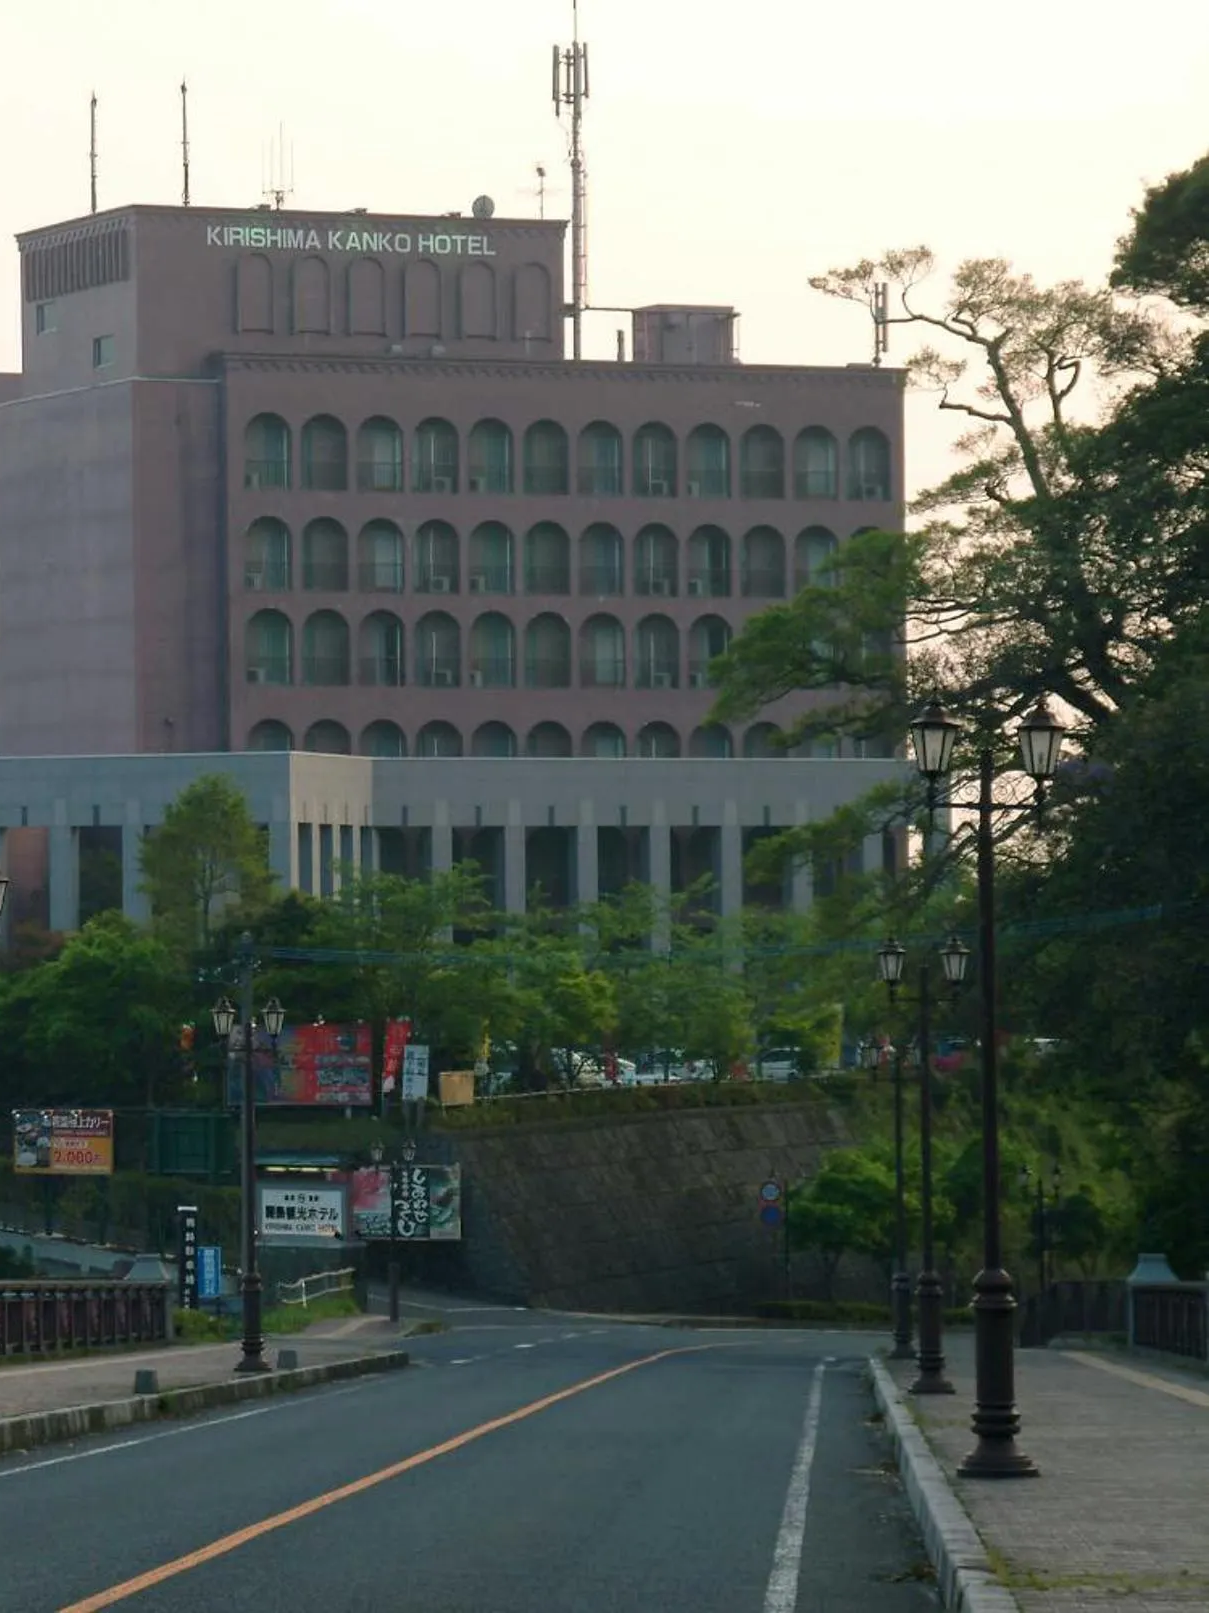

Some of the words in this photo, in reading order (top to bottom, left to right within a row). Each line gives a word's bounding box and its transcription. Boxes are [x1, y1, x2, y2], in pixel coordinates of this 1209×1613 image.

[206, 225, 321, 249] KIRISHIMA
[328, 230, 411, 252] KANKO
[418, 234, 496, 255] HOTEL
[265, 1205, 339, 1221] 光ホテル
